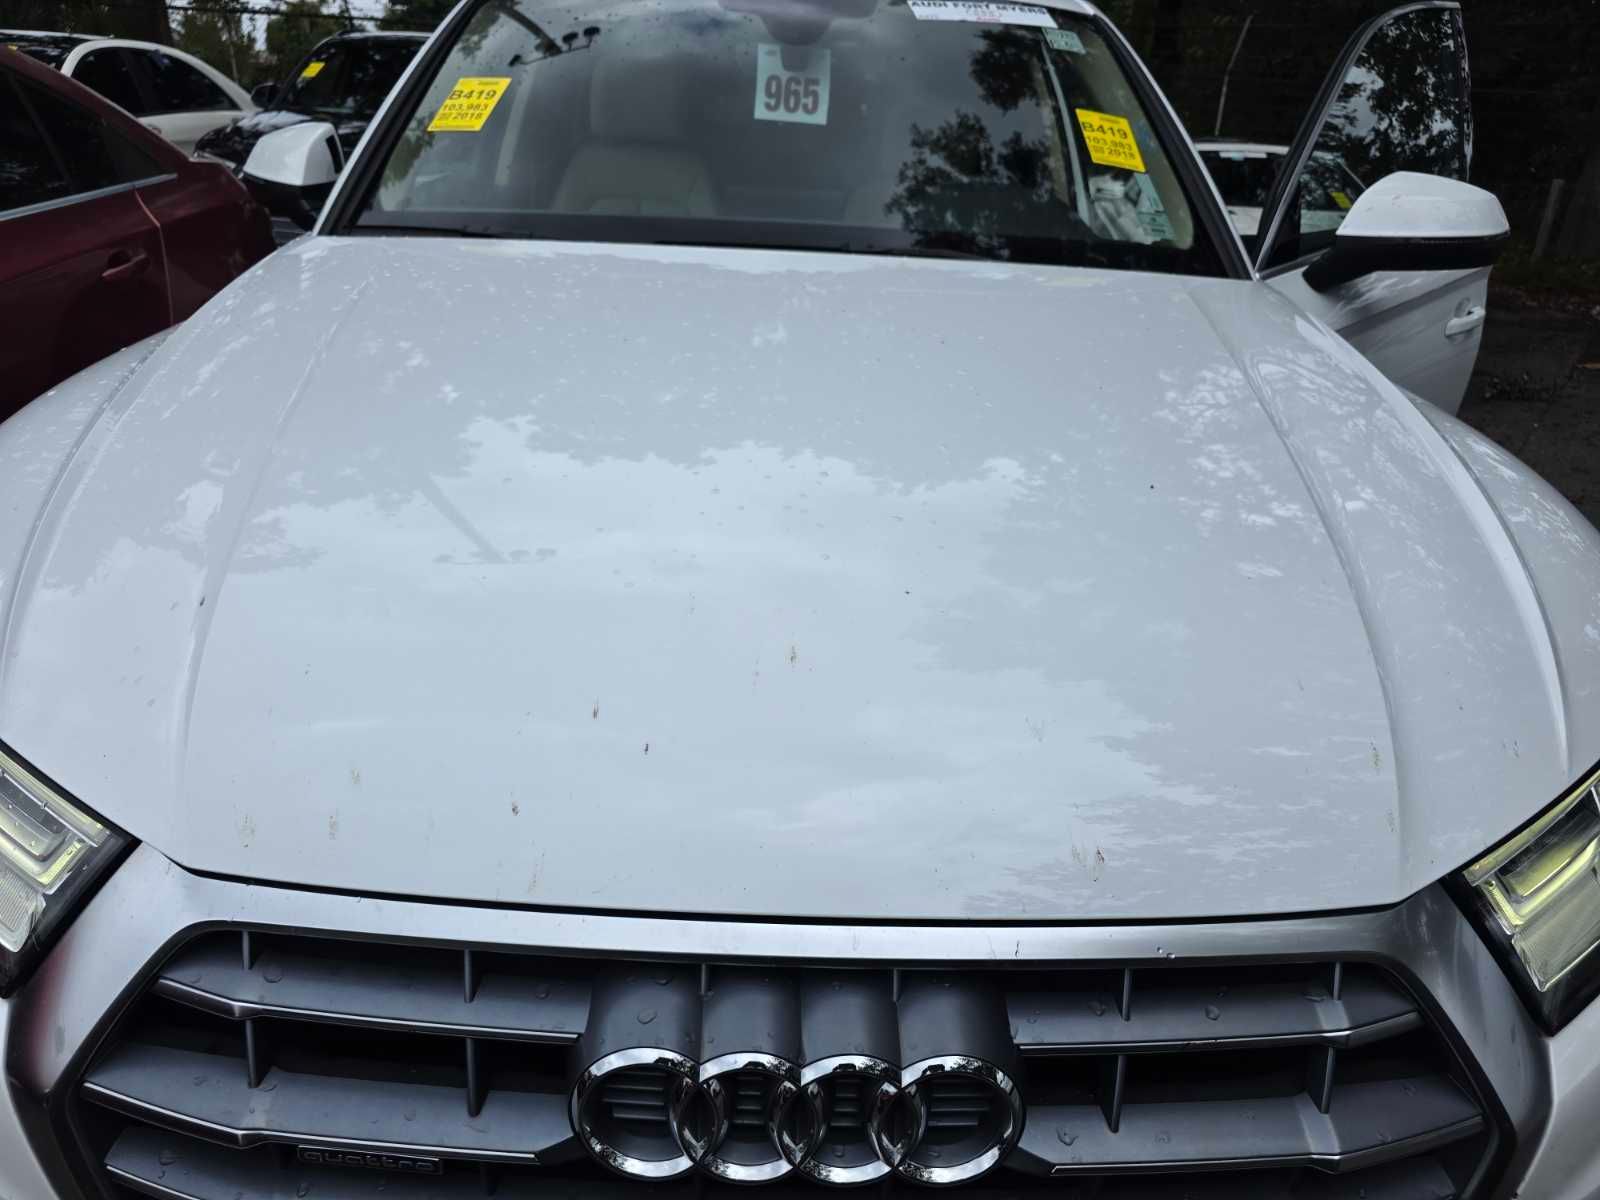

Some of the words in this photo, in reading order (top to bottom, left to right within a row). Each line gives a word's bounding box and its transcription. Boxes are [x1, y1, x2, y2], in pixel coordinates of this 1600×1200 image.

[448, 89, 497, 101] B419
[763, 74, 821, 115] 965
[1081, 121, 1128, 140] B419
[302, 1150, 435, 1172] quattro
